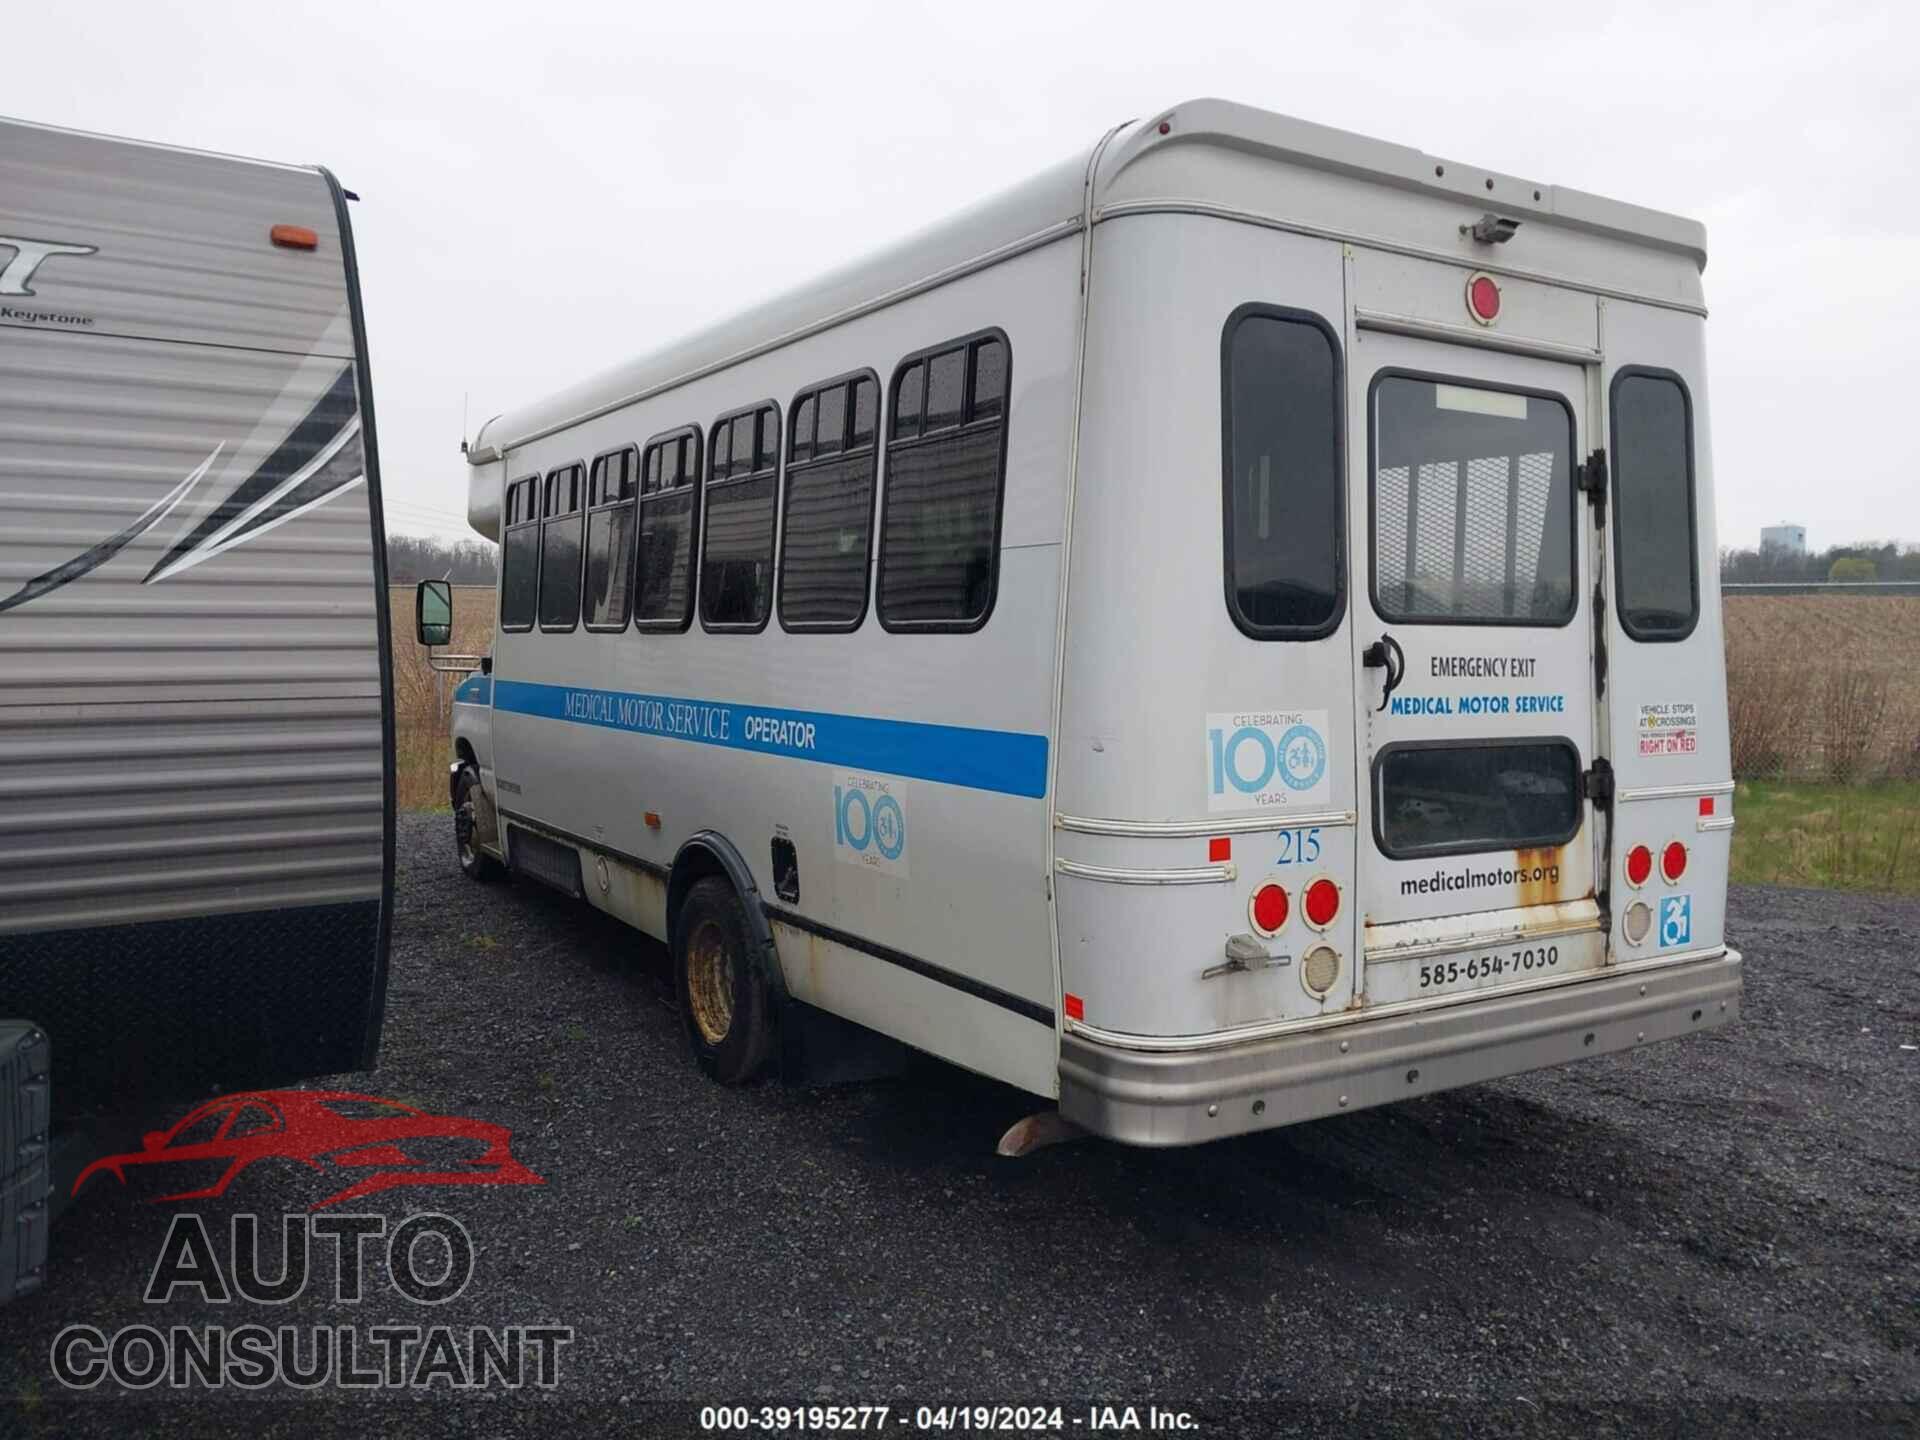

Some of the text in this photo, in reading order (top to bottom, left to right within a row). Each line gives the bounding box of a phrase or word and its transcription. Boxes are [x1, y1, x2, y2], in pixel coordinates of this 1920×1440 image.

[1, 307, 94, 325] Keystone
[1431, 657, 1536, 677] EMERGENCY EXIT
[1391, 695, 1564, 715] MEDICAL MOTOR SERVICE
[1640, 703, 1694, 714] VEHICLE STOPS
[564, 692, 816, 749] MEDICAL MOTOR SERVICE OPERATOR
[1233, 714, 1304, 727] CELEBRATING
[1656, 716, 1696, 727] CROSSINGS
[1640, 737, 1695, 753] RIGHT ON RED
[1209, 725, 1326, 794] 100
[1255, 793, 1287, 805] YEARS
[834, 785, 905, 860] 100
[1277, 828, 1321, 864] 215
[1401, 865, 1559, 895] medicalmotors.org
[1420, 946, 1559, 988] 585-654-7030
